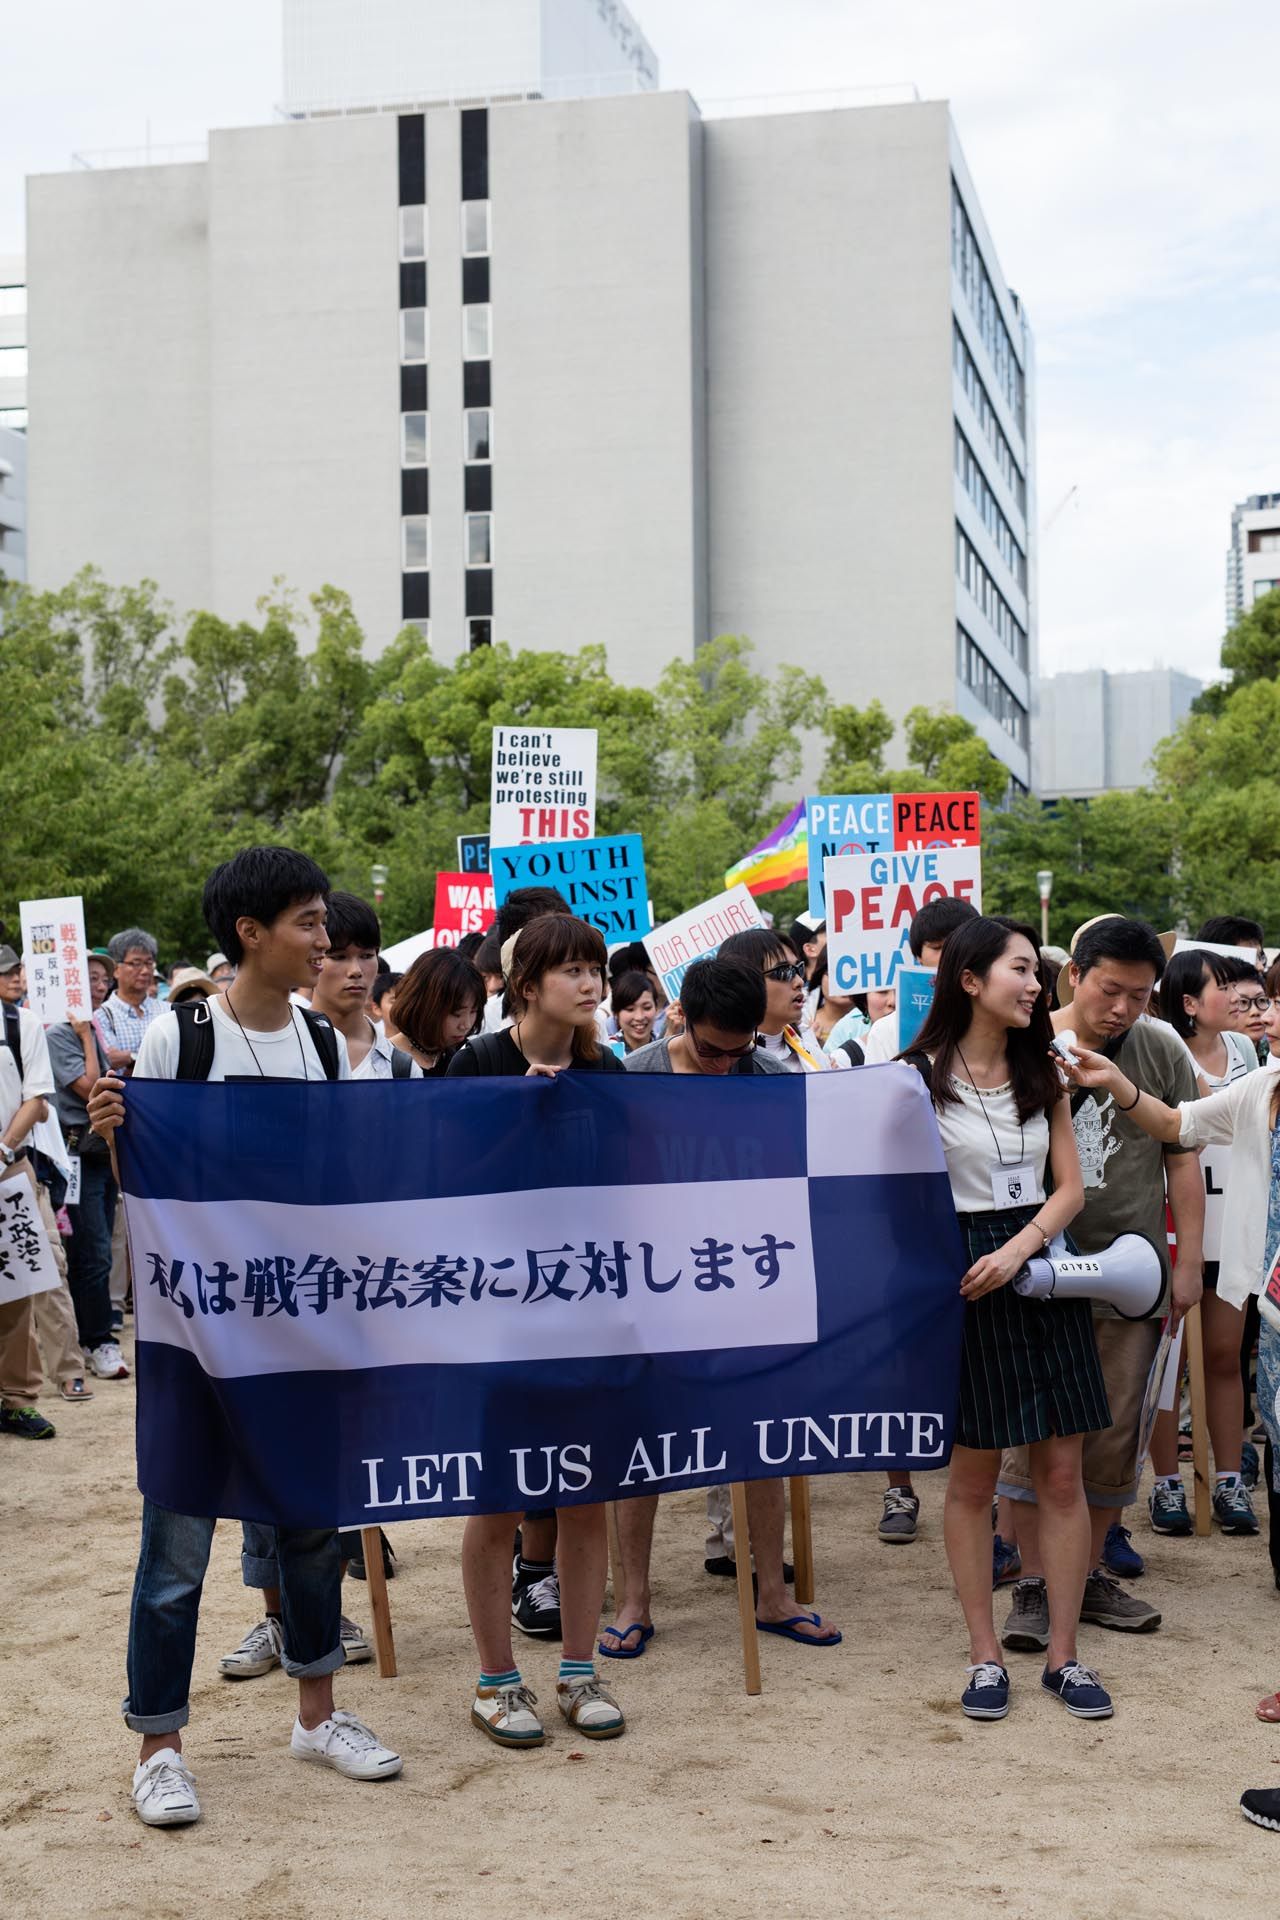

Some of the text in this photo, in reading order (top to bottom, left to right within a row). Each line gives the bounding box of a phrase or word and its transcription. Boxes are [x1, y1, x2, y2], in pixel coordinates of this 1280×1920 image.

[498, 731, 553, 749] I can't
[497, 750, 561, 768] believe
[496, 769, 583, 786] we're still
[496, 788, 588, 807] protesting
[519, 808, 590, 839] THIS
[811, 802, 890, 836] PEACE
[897, 801, 976, 833] PEACE
[501, 845, 630, 879] YOUTH
[870, 854, 938, 885] GIVE
[461, 908, 484, 932] IS
[652, 899, 757, 973] OUR FUTURE
[146, 1234, 796, 1318] 私は戦争法案に反対します
[361, 1412, 945, 1508] LET US ALL UNITE
